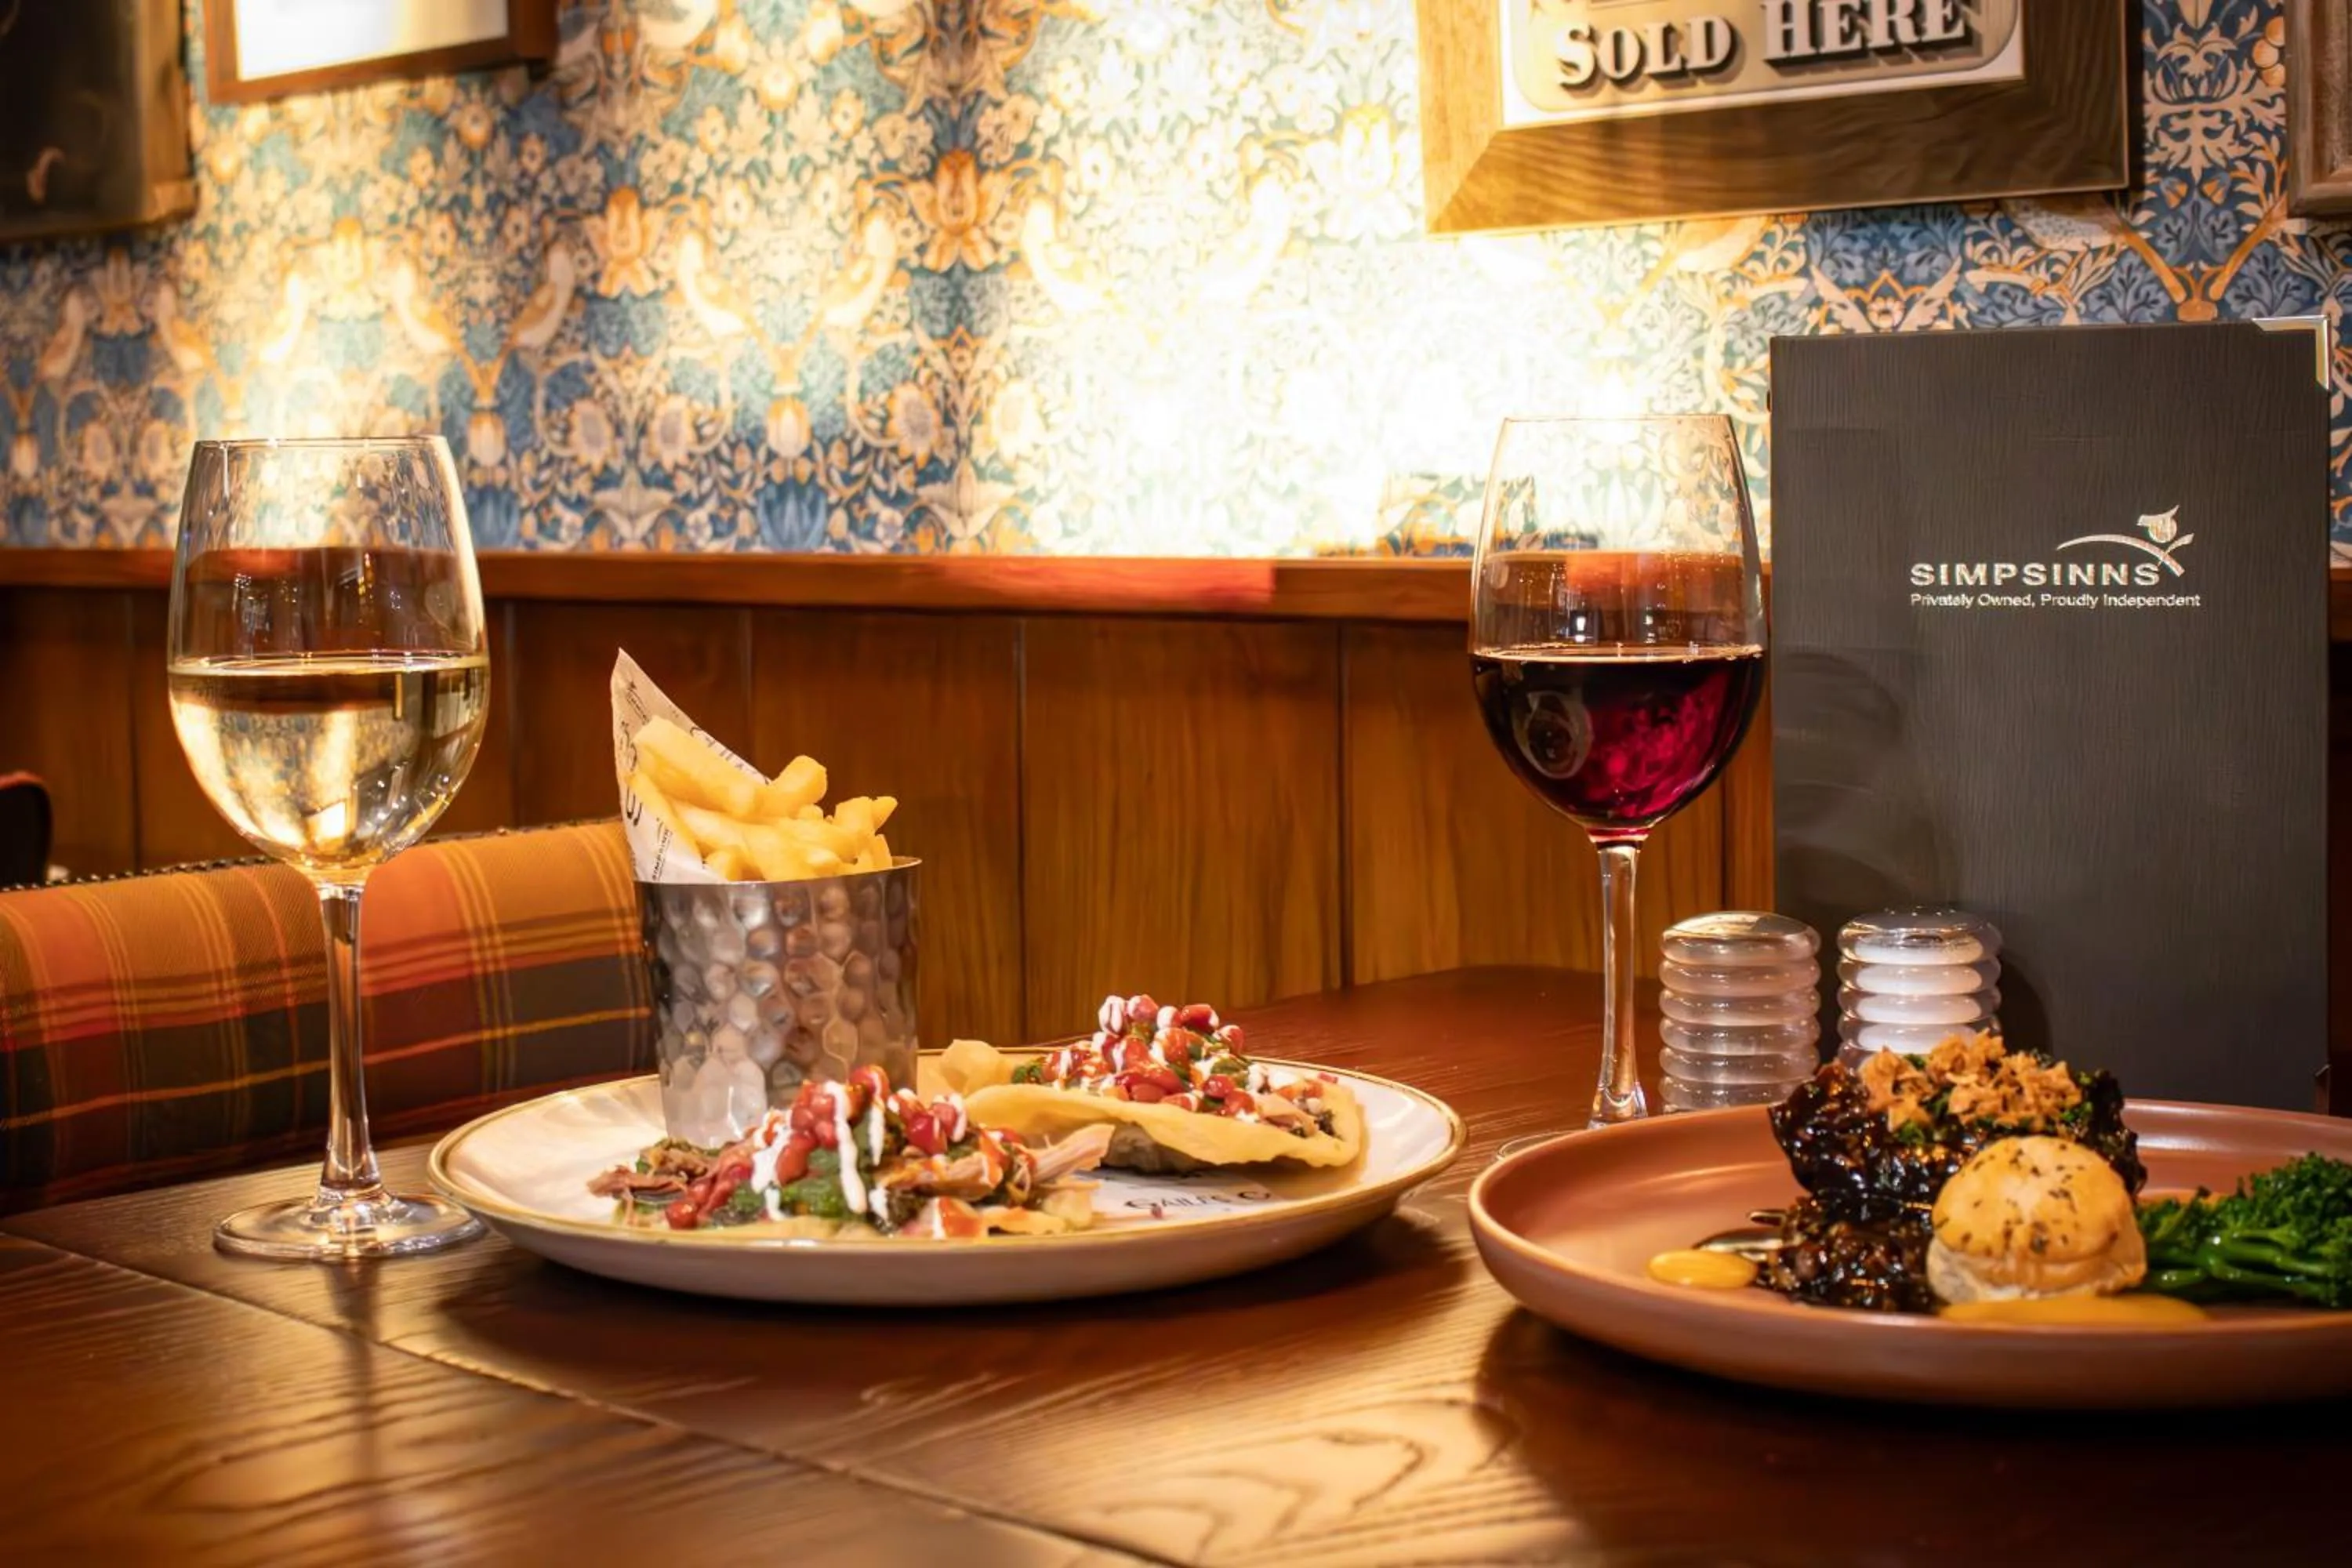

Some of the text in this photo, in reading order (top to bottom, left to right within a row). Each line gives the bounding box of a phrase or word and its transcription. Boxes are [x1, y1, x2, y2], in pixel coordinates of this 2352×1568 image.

[1554, 0, 1971, 89] SOLD HERE
[1910, 562, 2160, 586] SIMPSINNS
[1911, 593, 2202, 609] Privately Owned, Proudly Independent
